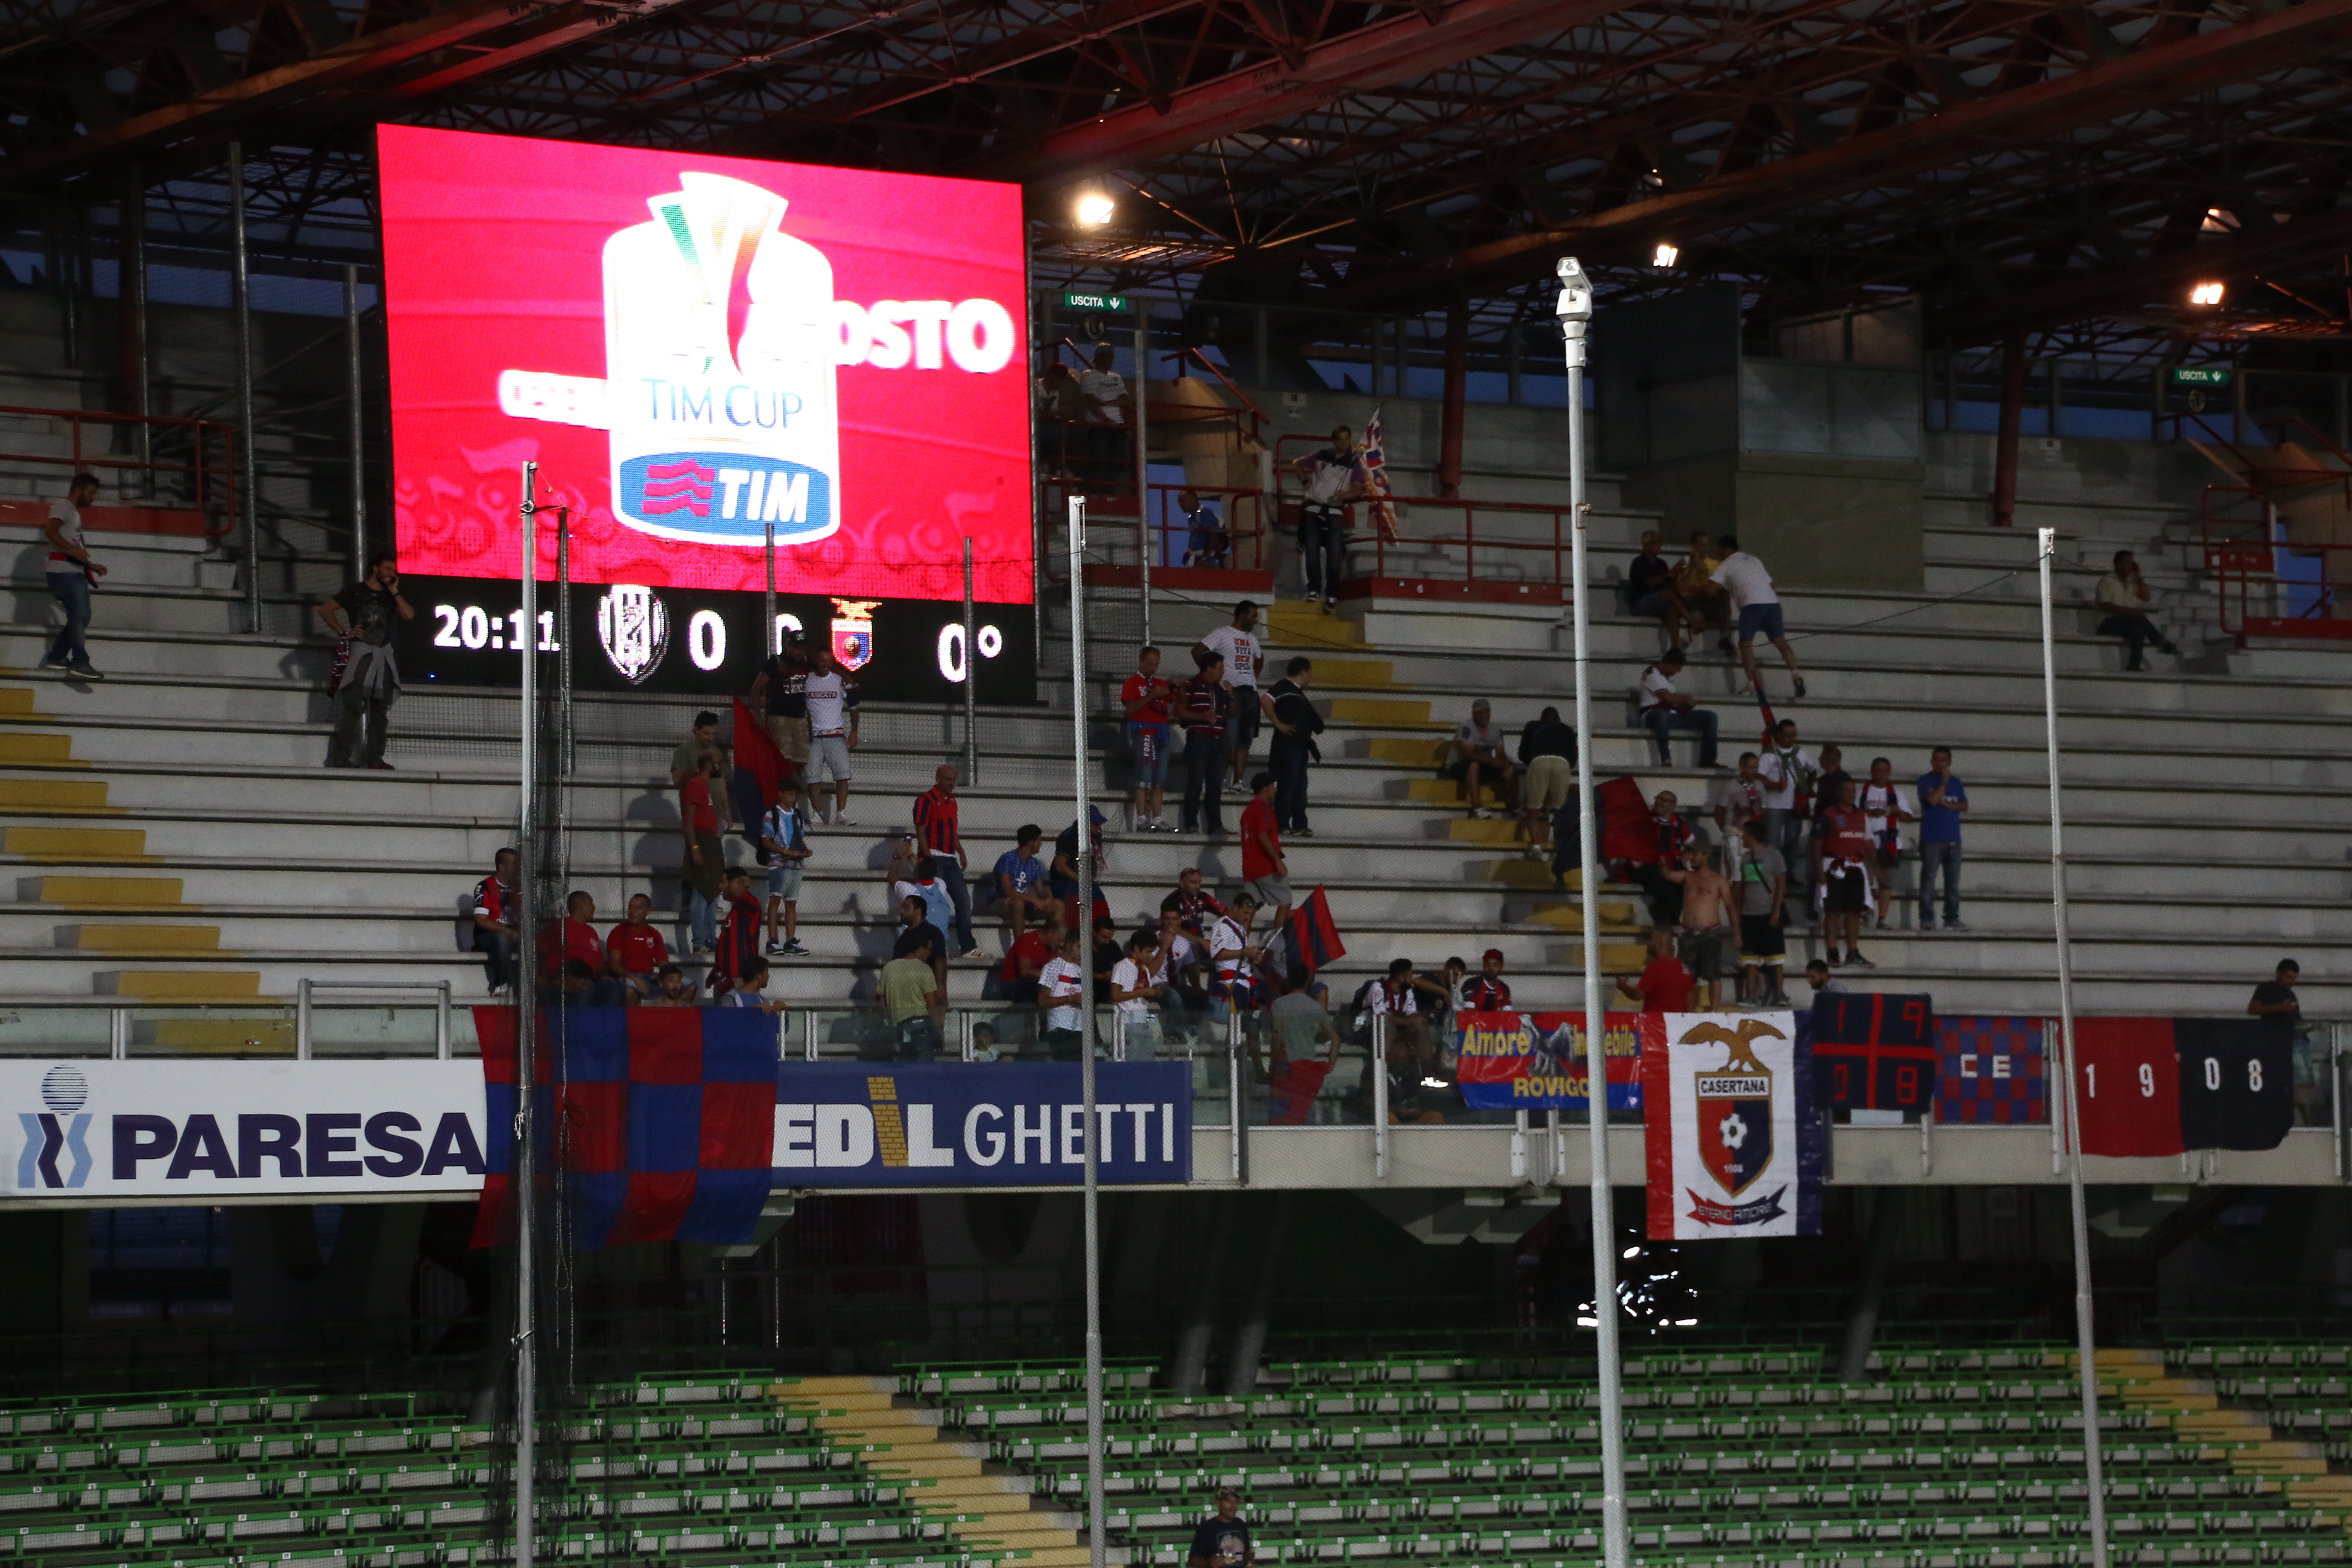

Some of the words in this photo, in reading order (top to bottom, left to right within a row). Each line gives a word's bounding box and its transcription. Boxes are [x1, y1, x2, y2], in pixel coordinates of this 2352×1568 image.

[1070, 295, 1104, 308] USCITA
[2178, 370, 2208, 381] USCITA
[640, 378, 713, 424] TIM
[725, 385, 803, 429] CUP
[719, 469, 810, 524] TIM
[433, 604, 561, 651] 20:11
[688, 609, 727, 671] 0
[1461, 1023, 1532, 1056] Amore
[1573, 1024, 1636, 1056] Inebile
[1700, 1080, 1766, 1093] CASERTANA
[112, 1111, 487, 1179] PARESA
[963, 1103, 1174, 1167] GHETTI
